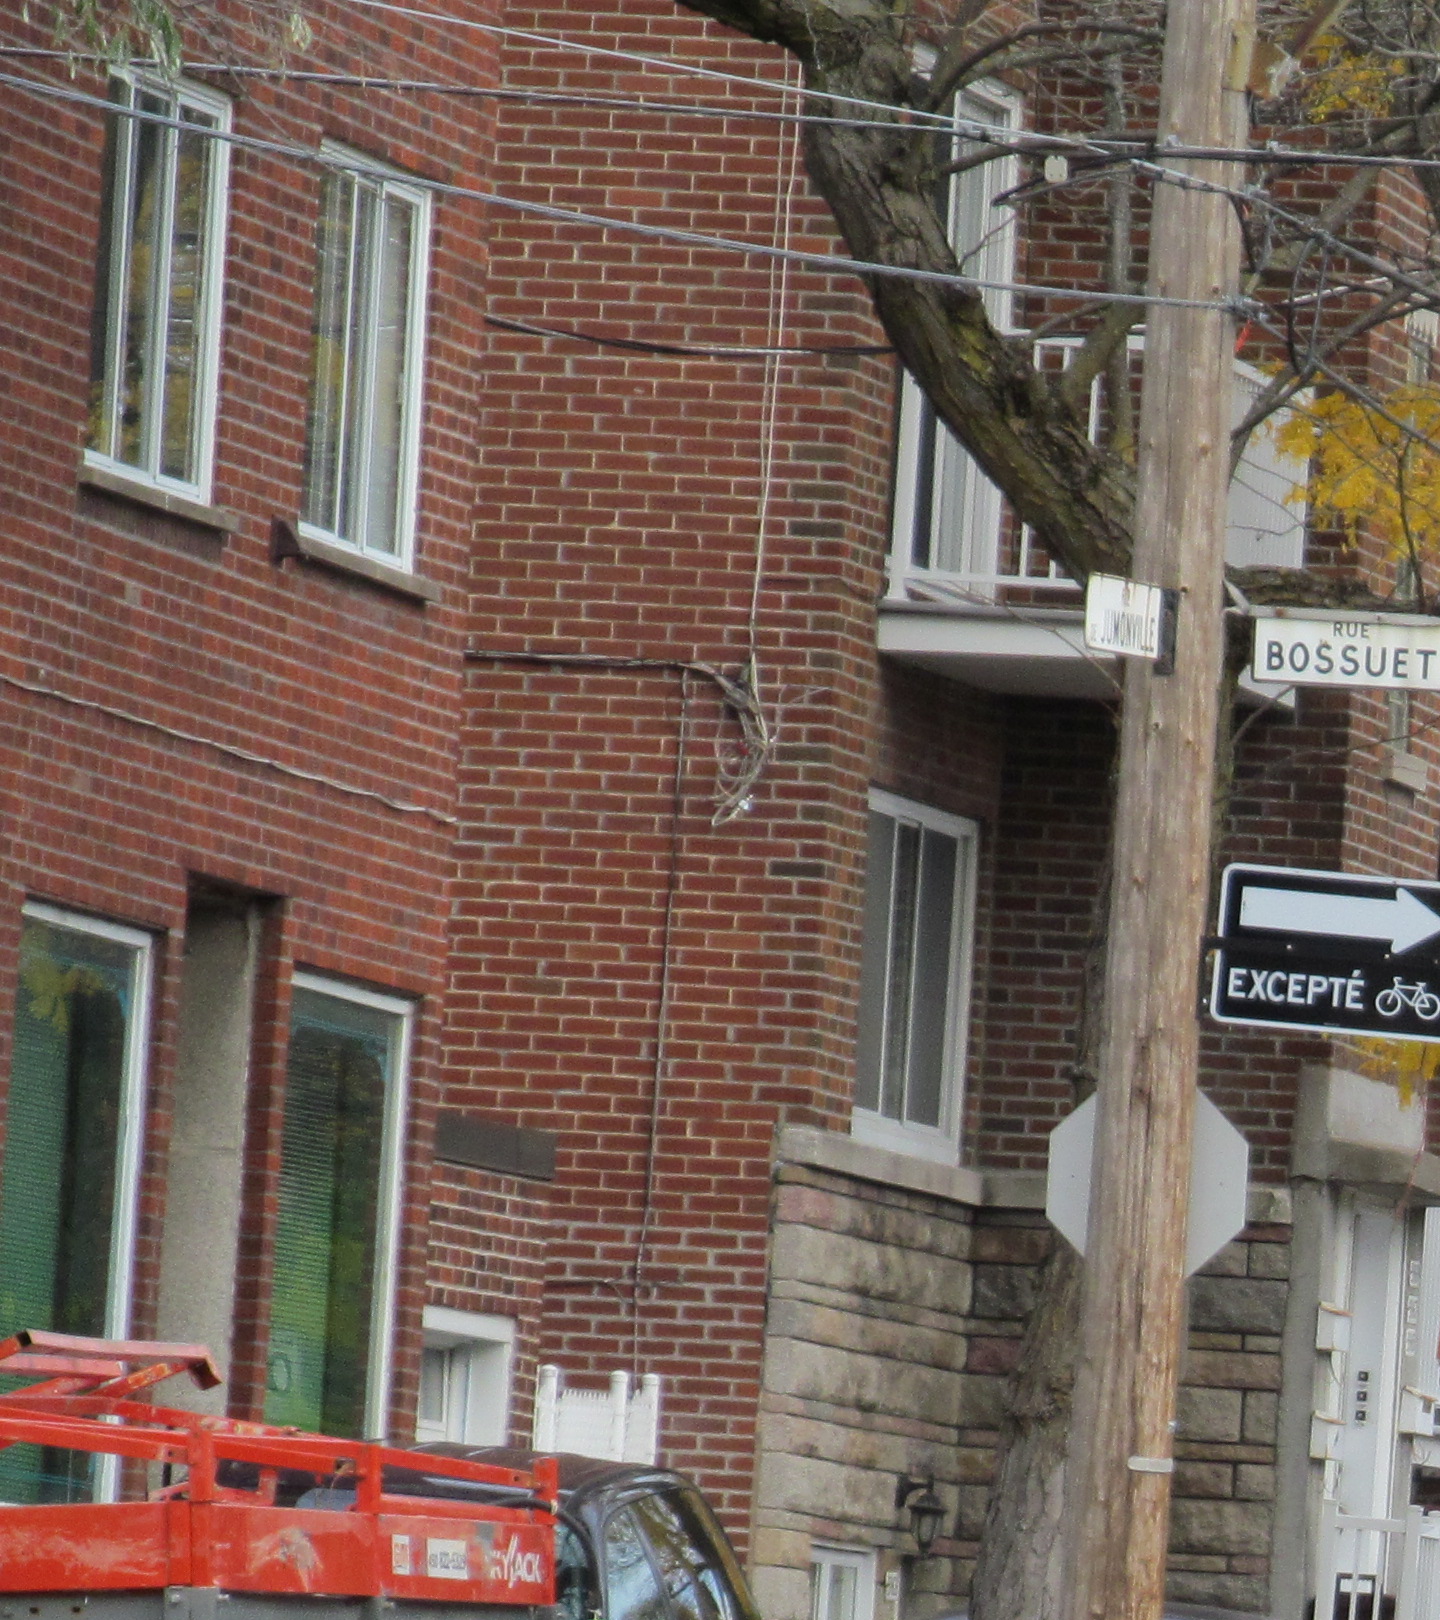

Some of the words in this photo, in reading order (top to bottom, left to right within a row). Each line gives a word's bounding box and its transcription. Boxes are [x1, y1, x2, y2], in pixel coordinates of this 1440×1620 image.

[1332, 622, 1370, 639] RUE
[1266, 640, 1437, 680] BOSSUET
[1227, 966, 1365, 1010] EXCEPTÉ
